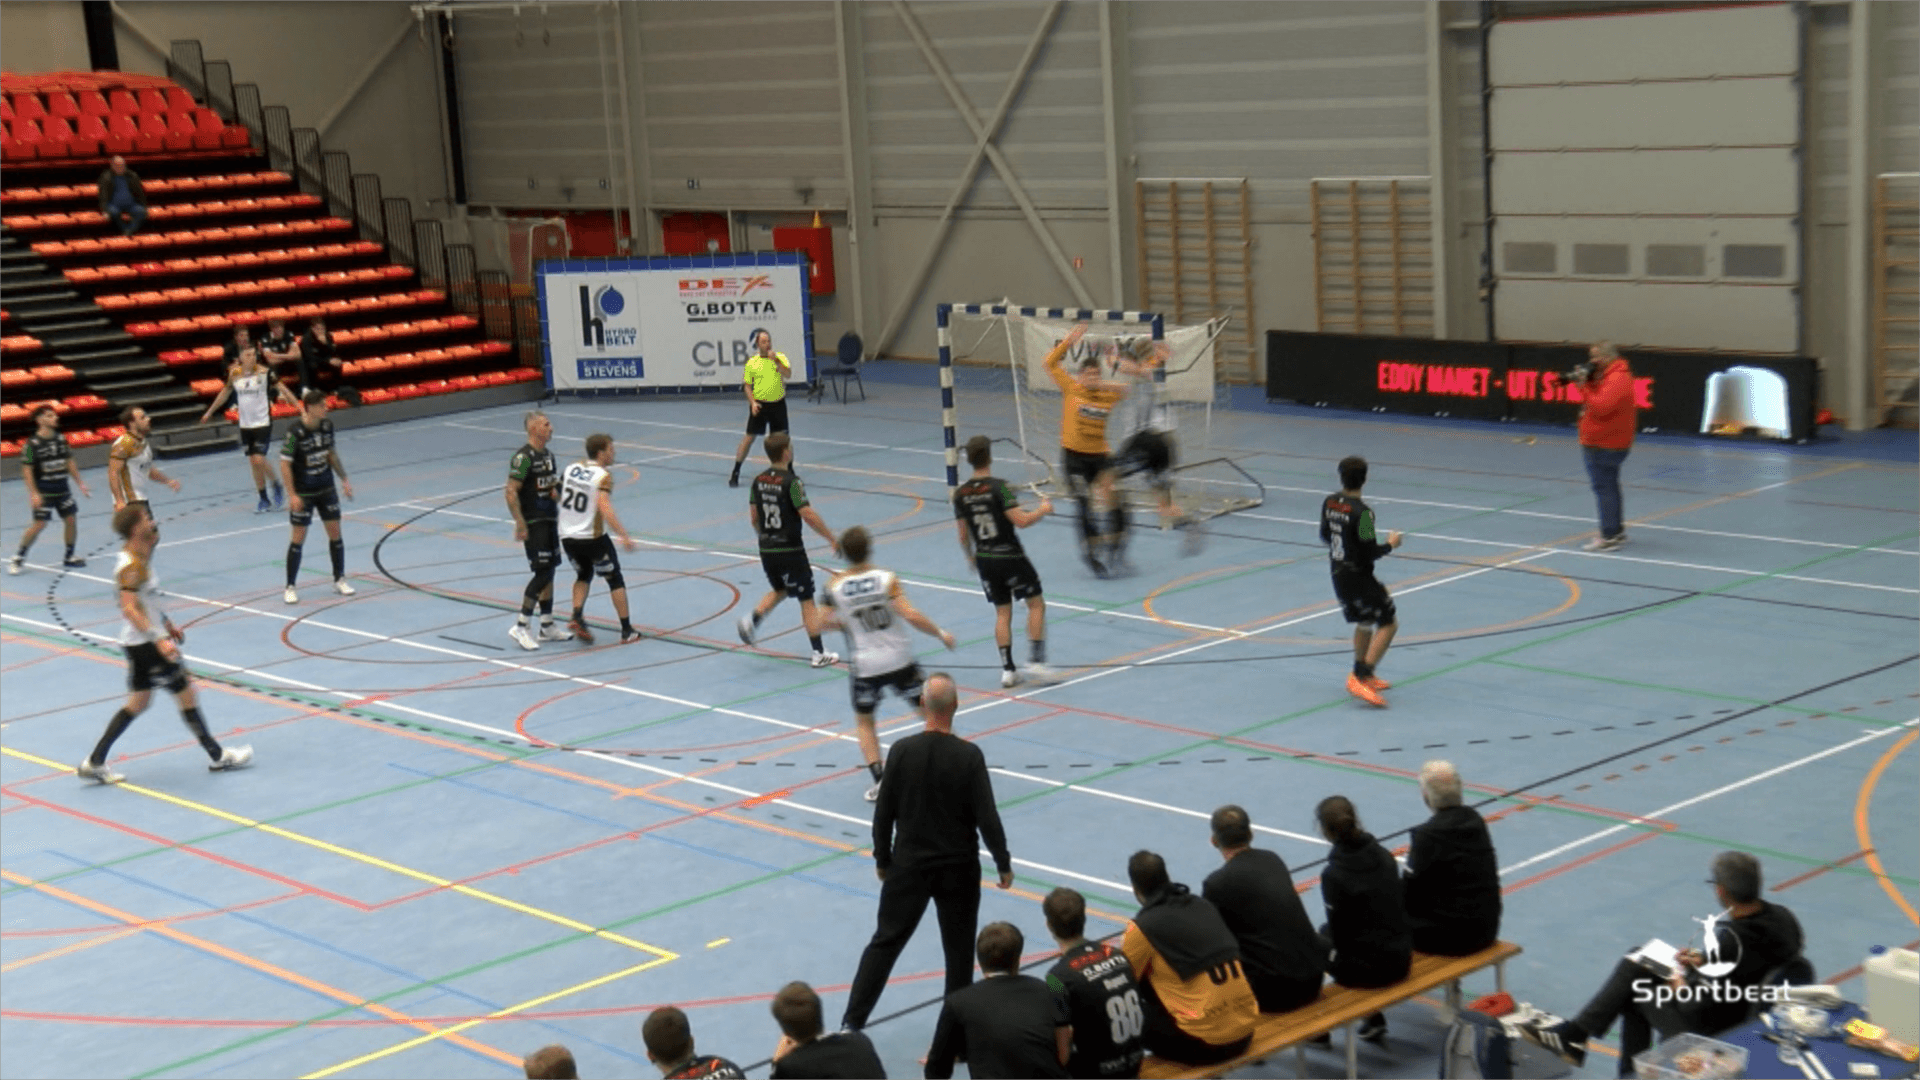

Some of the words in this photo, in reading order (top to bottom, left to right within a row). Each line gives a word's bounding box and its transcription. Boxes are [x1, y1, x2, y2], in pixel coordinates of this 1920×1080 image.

[678, 275, 774, 296] DEX
[686, 301, 776, 316] G.BOTTA
[606, 335, 637, 346] BELT
[692, 340, 749, 368] CLB
[583, 365, 638, 378] STEVENS
[1377, 362, 1425, 393] EDDY
[1506, 369, 1539, 400] UIT
[562, 487, 589, 513] 20
